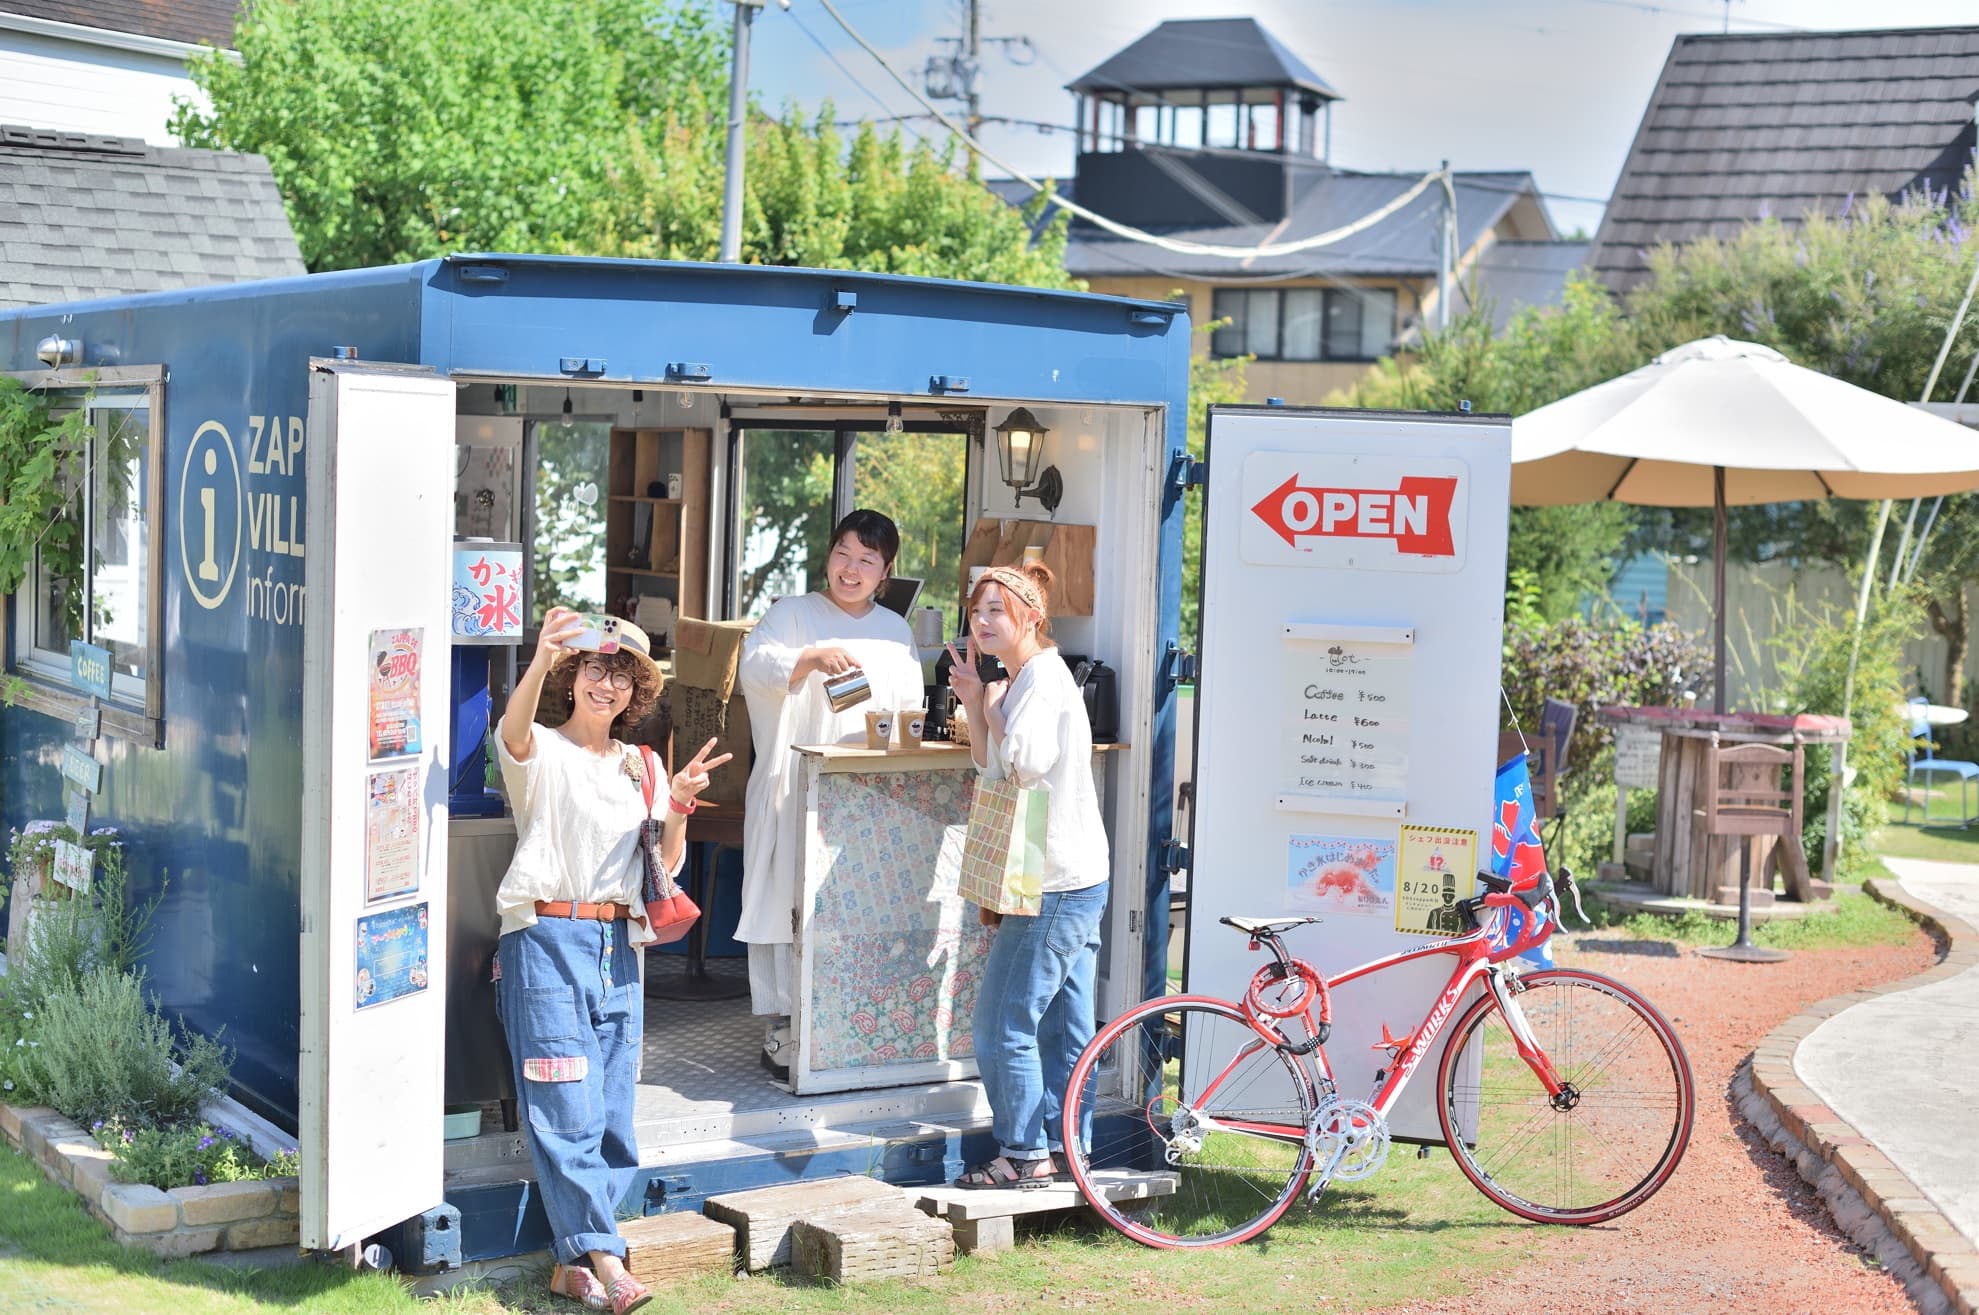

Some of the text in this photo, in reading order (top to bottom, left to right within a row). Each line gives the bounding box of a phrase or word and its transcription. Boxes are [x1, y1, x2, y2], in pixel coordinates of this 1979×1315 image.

[248, 415, 304, 476] ZAP
[247, 492, 305, 557] VILL
[1281, 490, 1428, 535] OPEN
[77, 655, 105, 685] COFFEE
[389, 652, 417, 679] BBQ
[1304, 684, 1344, 701] Coffee
[1304, 708, 1338, 722] Latte
[1403, 881, 1439, 895] 8/20
[1401, 982, 1460, 1078] S-WORKS
